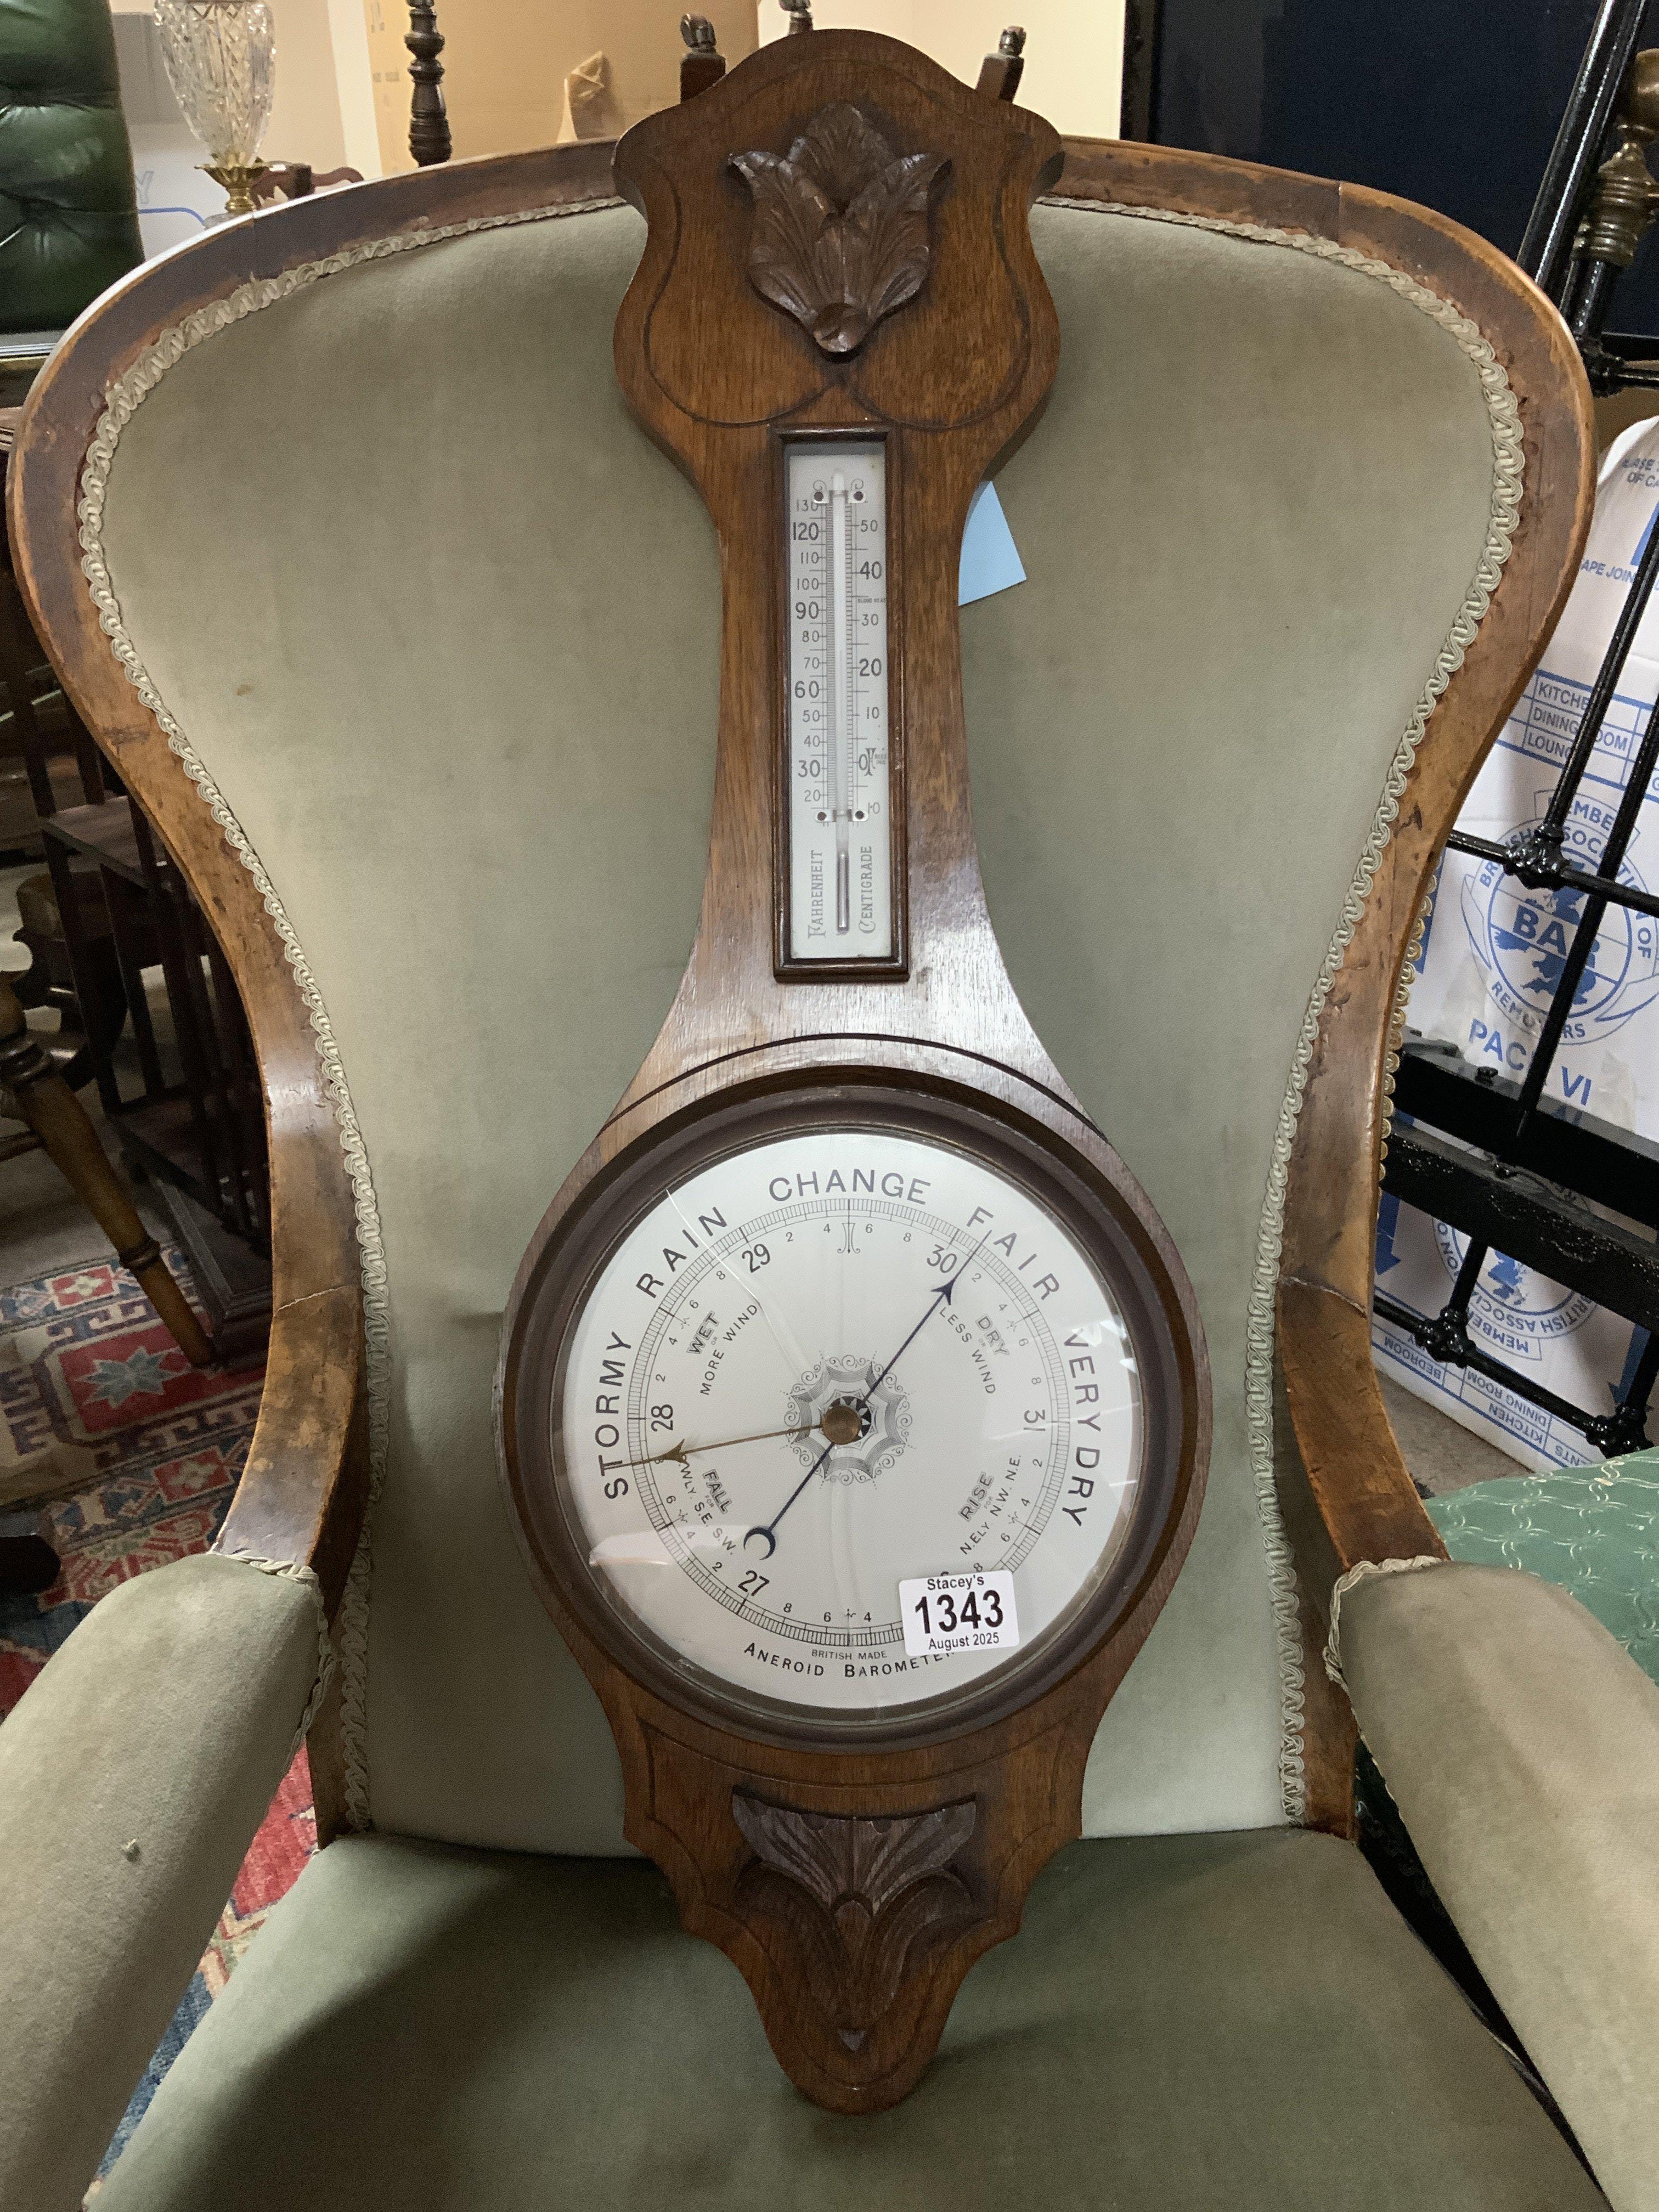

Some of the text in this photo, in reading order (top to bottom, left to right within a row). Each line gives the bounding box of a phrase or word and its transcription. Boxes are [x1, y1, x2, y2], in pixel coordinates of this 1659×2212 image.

[792, 522, 820, 541] 120
[860, 519, 878, 533] 50
[800, 551, 820, 565] 110
[860, 561, 883, 580] 40
[797, 578, 820, 590] 100
[795, 601, 820, 620] 90
[861, 613, 879, 627] 30
[802, 629, 820, 643] 80
[804, 657, 820, 670] 70
[859, 658, 882, 678] 20
[794, 680, 820, 699] 60
[1538, 682, 1590, 710] KITCHE
[803, 709, 820, 723] 50
[866, 707, 880, 719] 10
[804, 735, 821, 748] 40
[1528, 732, 1573, 758] LOUN
[1594, 729, 1628, 752] OOM
[798, 760, 821, 778] 30
[804, 789, 821, 803] 20
[808, 850, 826, 939] FAHRENHEIT
[858, 845, 876, 934] CENTIGRADE
[1637, 927, 1651, 959] OF
[1491, 981, 1585, 1039] REMORS
[1469, 1018, 1536, 1071] PAC
[769, 1169, 932, 1205] CHANGE
[823, 1223, 831, 1233] 4
[865, 1223, 873, 1234] 6
[785, 1232, 794, 1243] 2
[902, 1232, 912, 1243] 8
[635, 1206, 728, 1299] RAIN
[741, 1244, 771, 1273] 29
[926, 1244, 958, 1274] 30
[966, 1206, 1060, 1300] FAIR
[716, 1270, 726, 1281] 8
[971, 1272, 982, 1283] 2
[689, 1300, 699, 1309] 6
[998, 1303, 1008, 1312] 4
[668, 1336, 678, 1345] 4
[686, 1310, 720, 1355] WET
[710, 1336, 718, 1346] OR
[974, 1313, 1011, 1356] DRY
[699, 1305, 758, 1395] MORE WIND
[939, 1307, 996, 1394] LESS WIND
[1018, 1338, 1029, 1347] 6
[1385, 1337, 1442, 1380] BEDROOM
[656, 1373, 666, 1383] 2
[1031, 1376, 1042, 1385] 8
[1467, 1370, 1547, 1427] DINING ROOM
[595, 1330, 631, 1499] STORMY
[651, 1404, 674, 1432] 28
[1062, 1327, 1102, 1527] VERY DRY
[1488, 1402, 1544, 1445] KITCHEN
[1032, 1458, 1043, 1468] 2
[702, 1469, 732, 1515] FALL
[989, 1487, 1012, 1517] N.W.
[1005, 1454, 1022, 1481] N.E.
[666, 1495, 676, 1504] 6
[704, 1494, 714, 1508] FOR
[958, 1471, 995, 1522] RISE
[983, 1496, 994, 1509] FOR
[1021, 1498, 1031, 1507] 4
[687, 1531, 696, 1539] 4
[694, 1502, 713, 1527] S.E.
[713, 1527, 736, 1555] S.W.
[1000, 1532, 1011, 1543] 6
[712, 1561, 723, 1572] 2
[973, 1562, 983, 1573] 8
[738, 1571, 770, 1598] 27
[927, 1575, 985, 1591] Stacey's
[783, 1602, 792, 1613] 8
[915, 1589, 1004, 1634] 1343
[823, 1611, 832, 1622] 6
[864, 1611, 872, 1622] 4
[928, 1632, 1000, 1651] August 2025
[744, 1642, 824, 1676] ANEROID
[811, 1649, 888, 1660] BRITISH MADE
